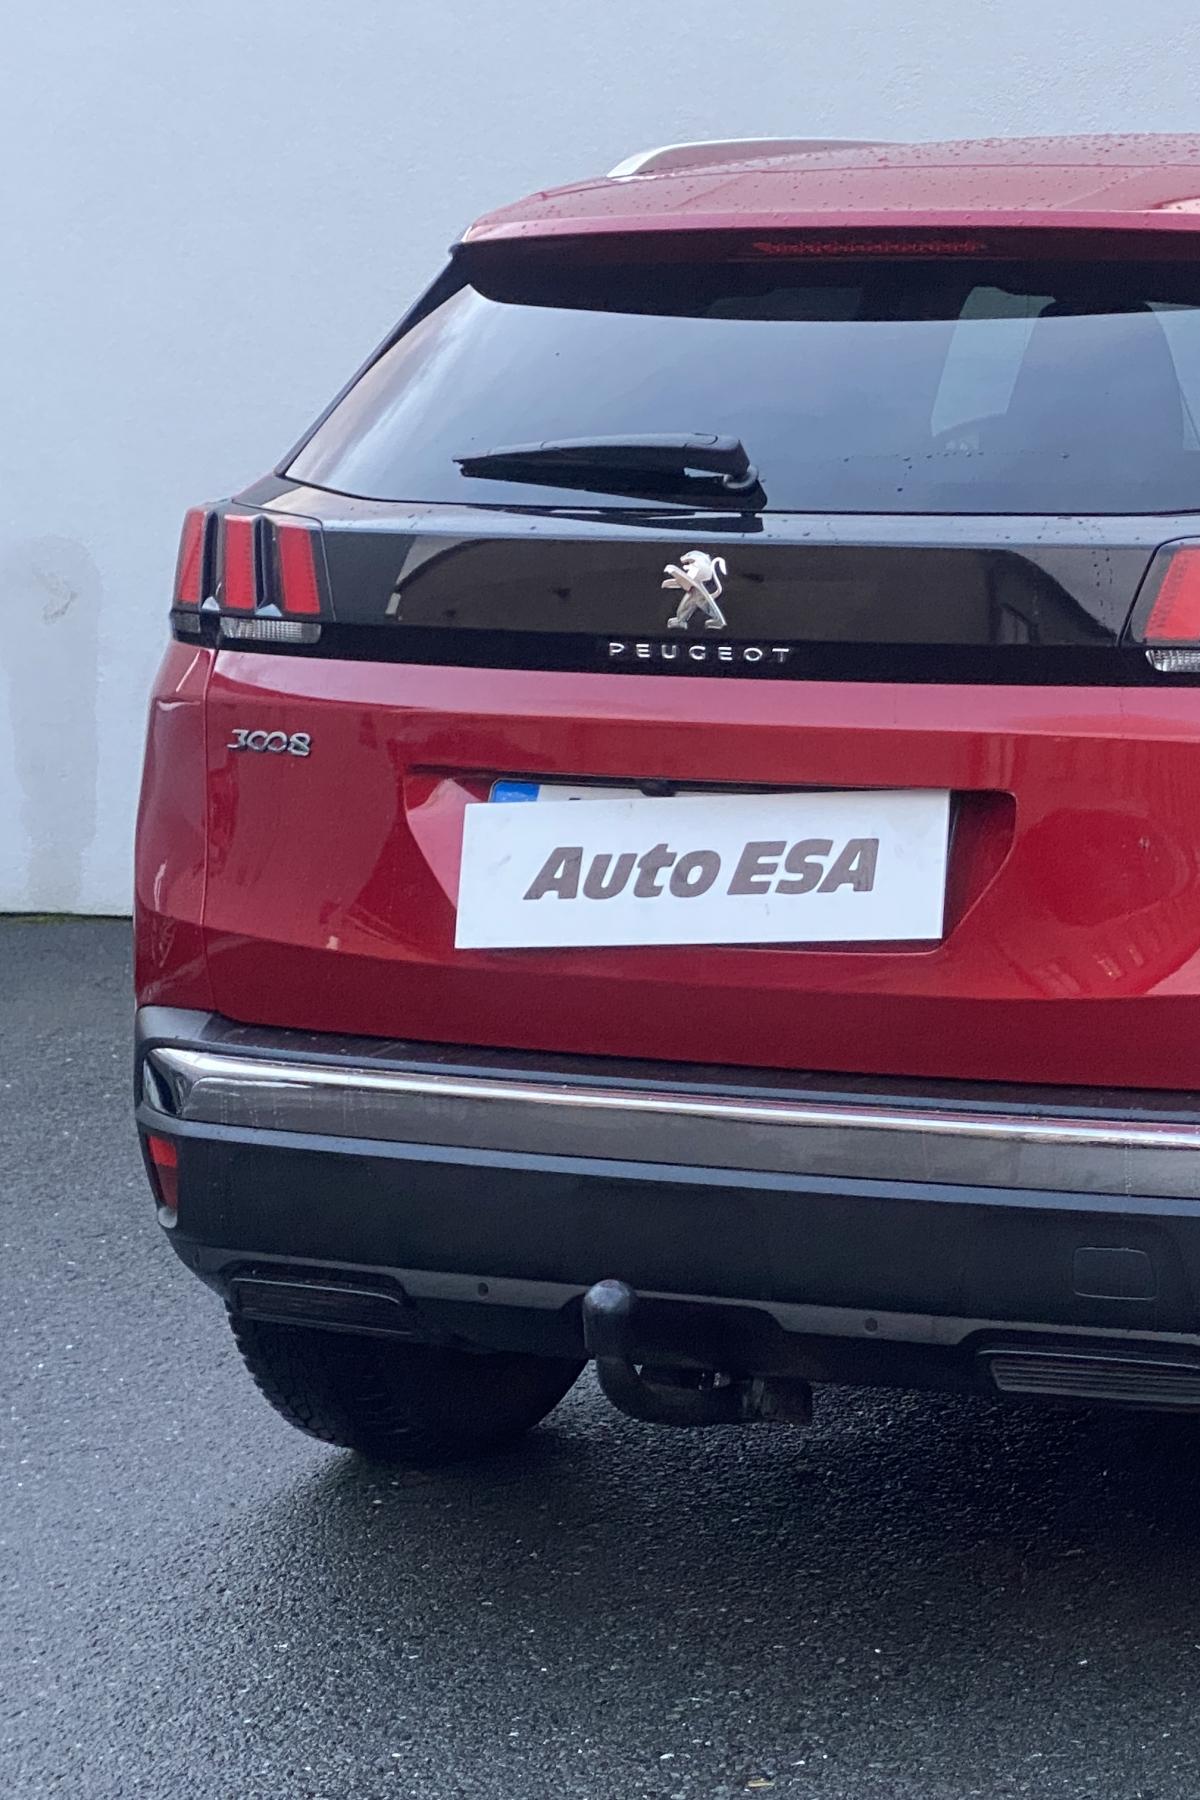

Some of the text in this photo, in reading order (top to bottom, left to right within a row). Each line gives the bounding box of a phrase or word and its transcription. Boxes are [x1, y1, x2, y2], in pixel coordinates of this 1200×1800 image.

[608, 641, 790, 663] PEUGEOT
[226, 728, 311, 757] 3008
[523, 838, 880, 901] Auto ESA
